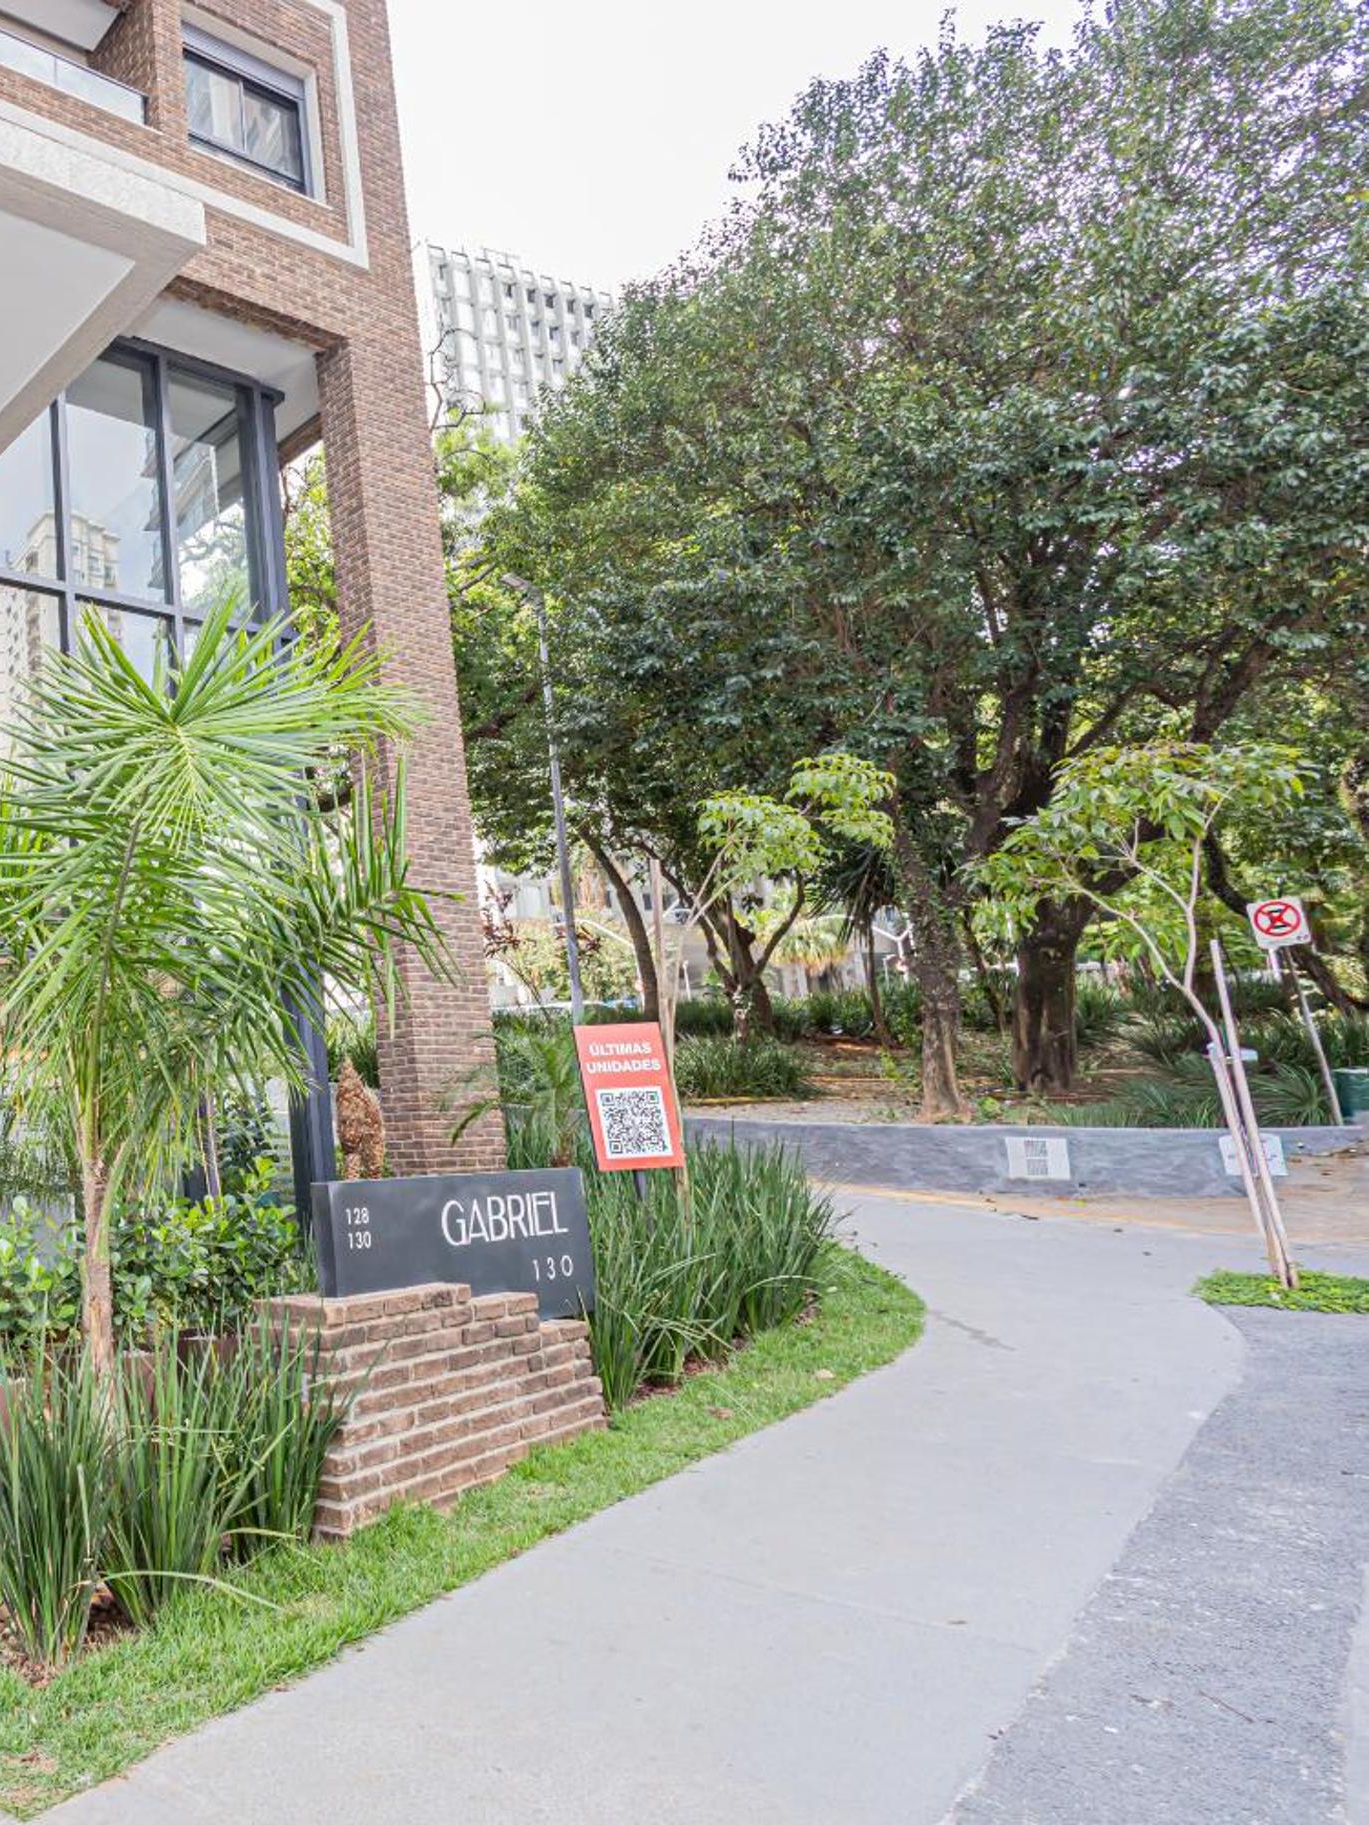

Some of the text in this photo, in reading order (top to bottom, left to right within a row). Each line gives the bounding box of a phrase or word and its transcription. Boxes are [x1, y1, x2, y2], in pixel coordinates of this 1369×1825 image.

[589, 1041, 652, 1056] ÚLTIMAS
[586, 1058, 662, 1074] UNIDADES
[345, 1207, 370, 1225] 128
[441, 1191, 569, 1246] GABRIEL
[348, 1231, 372, 1249] 130
